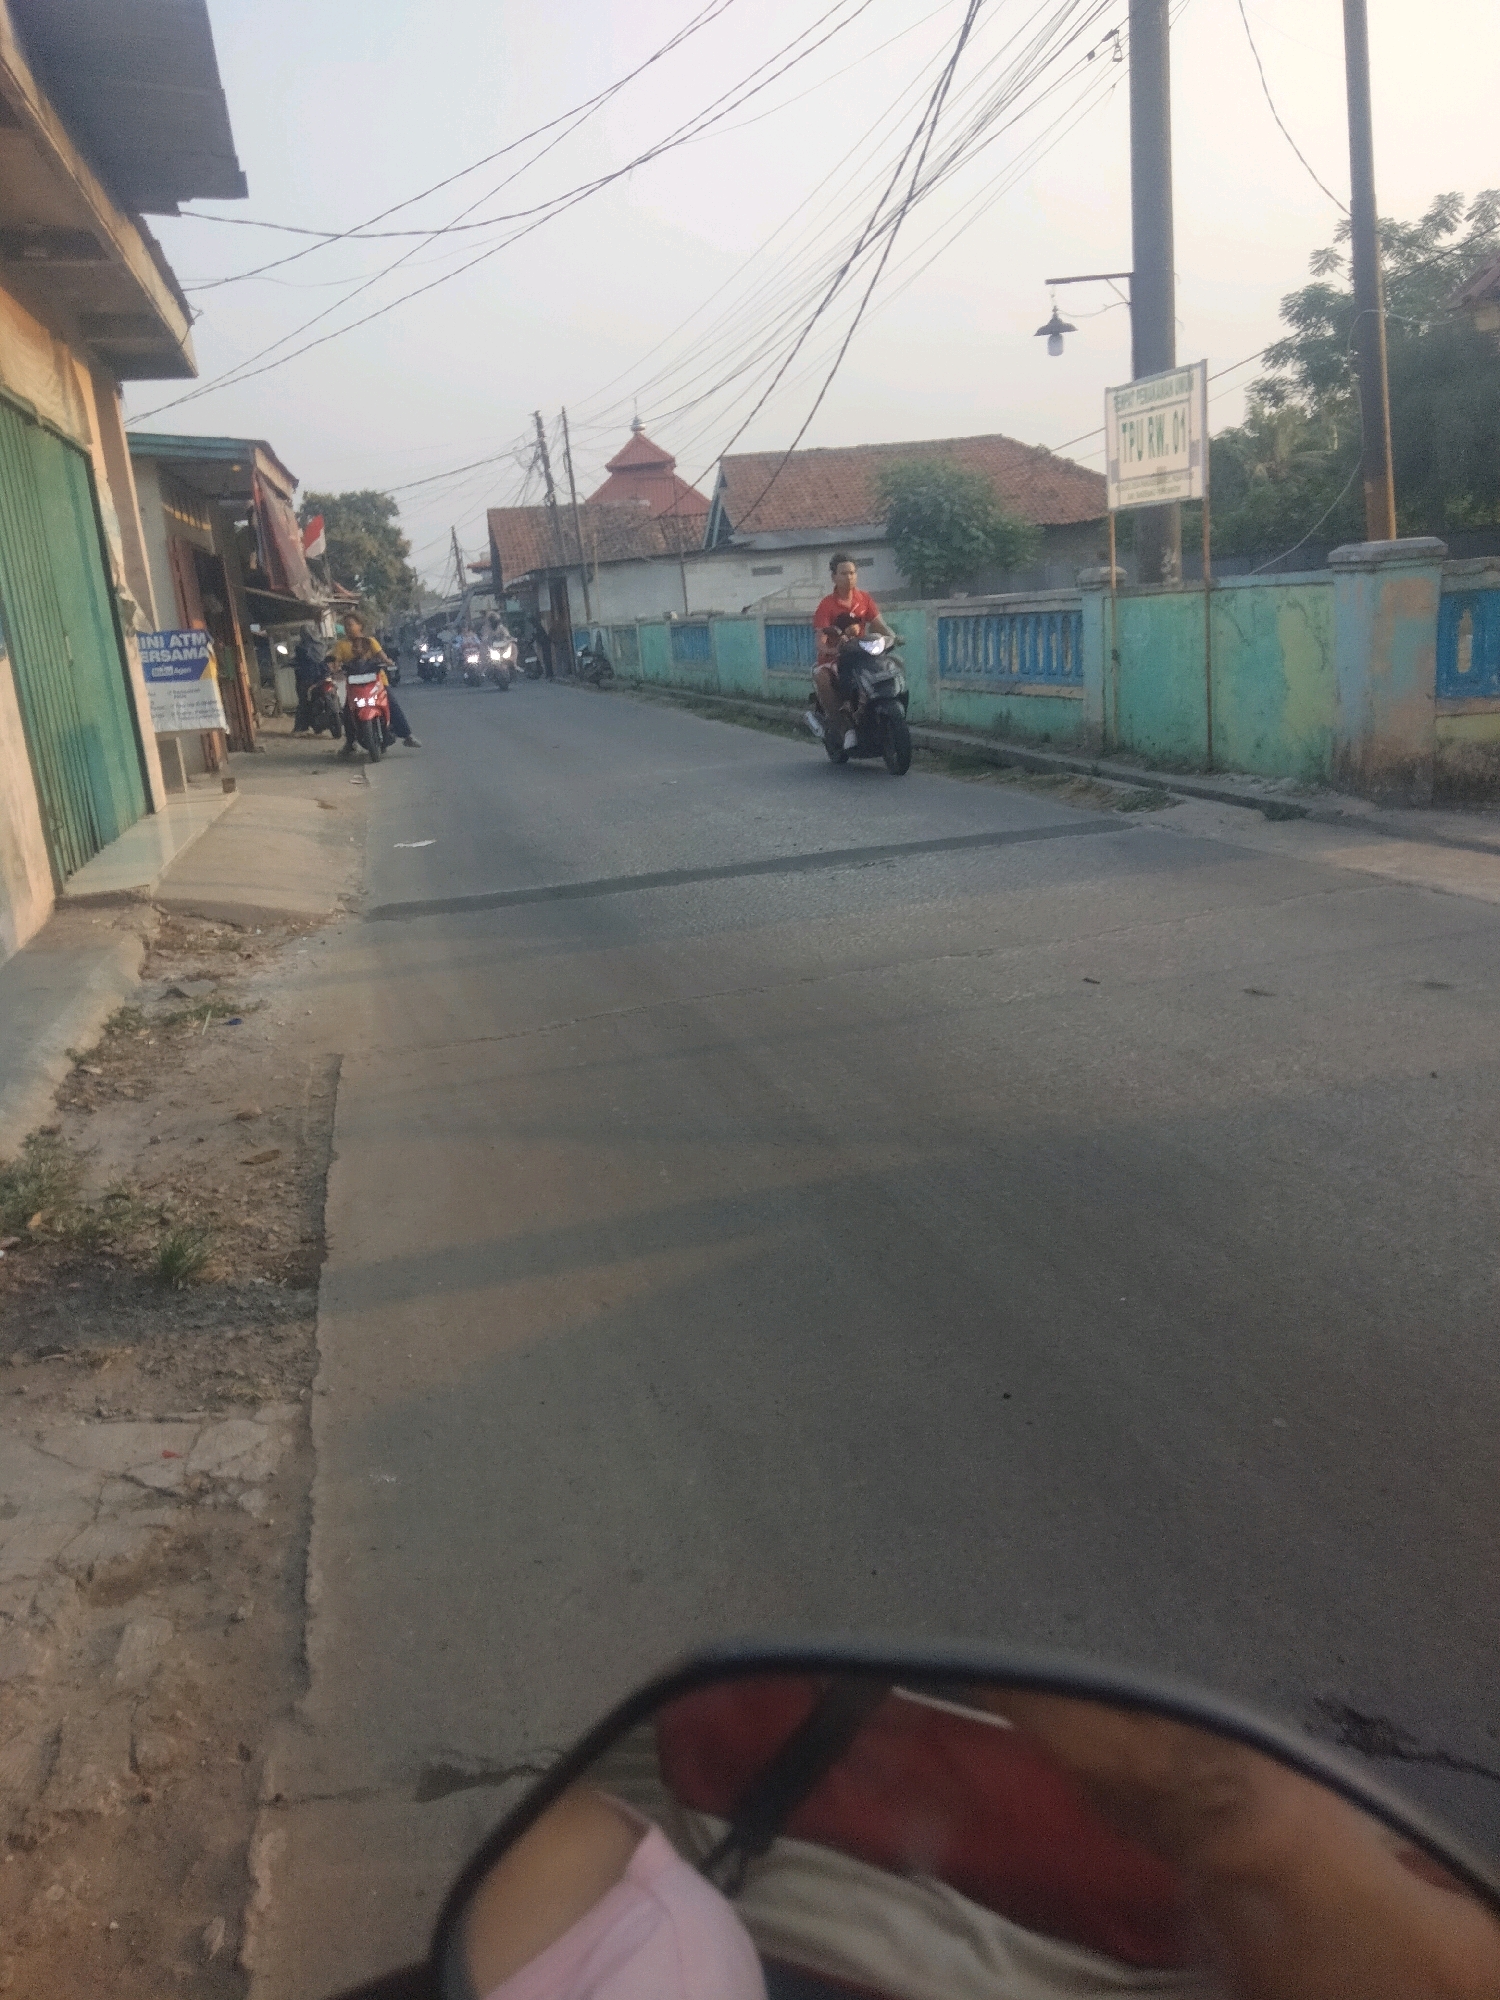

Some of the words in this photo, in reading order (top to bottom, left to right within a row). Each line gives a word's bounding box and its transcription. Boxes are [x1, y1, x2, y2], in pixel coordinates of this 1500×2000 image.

[1122, 419, 1143, 463] TPU
[1173, 407, 1185, 454] 01
[139, 634, 165, 649] INI
[170, 632, 206, 648] ATM
[140, 646, 209, 662] ERSAMA
